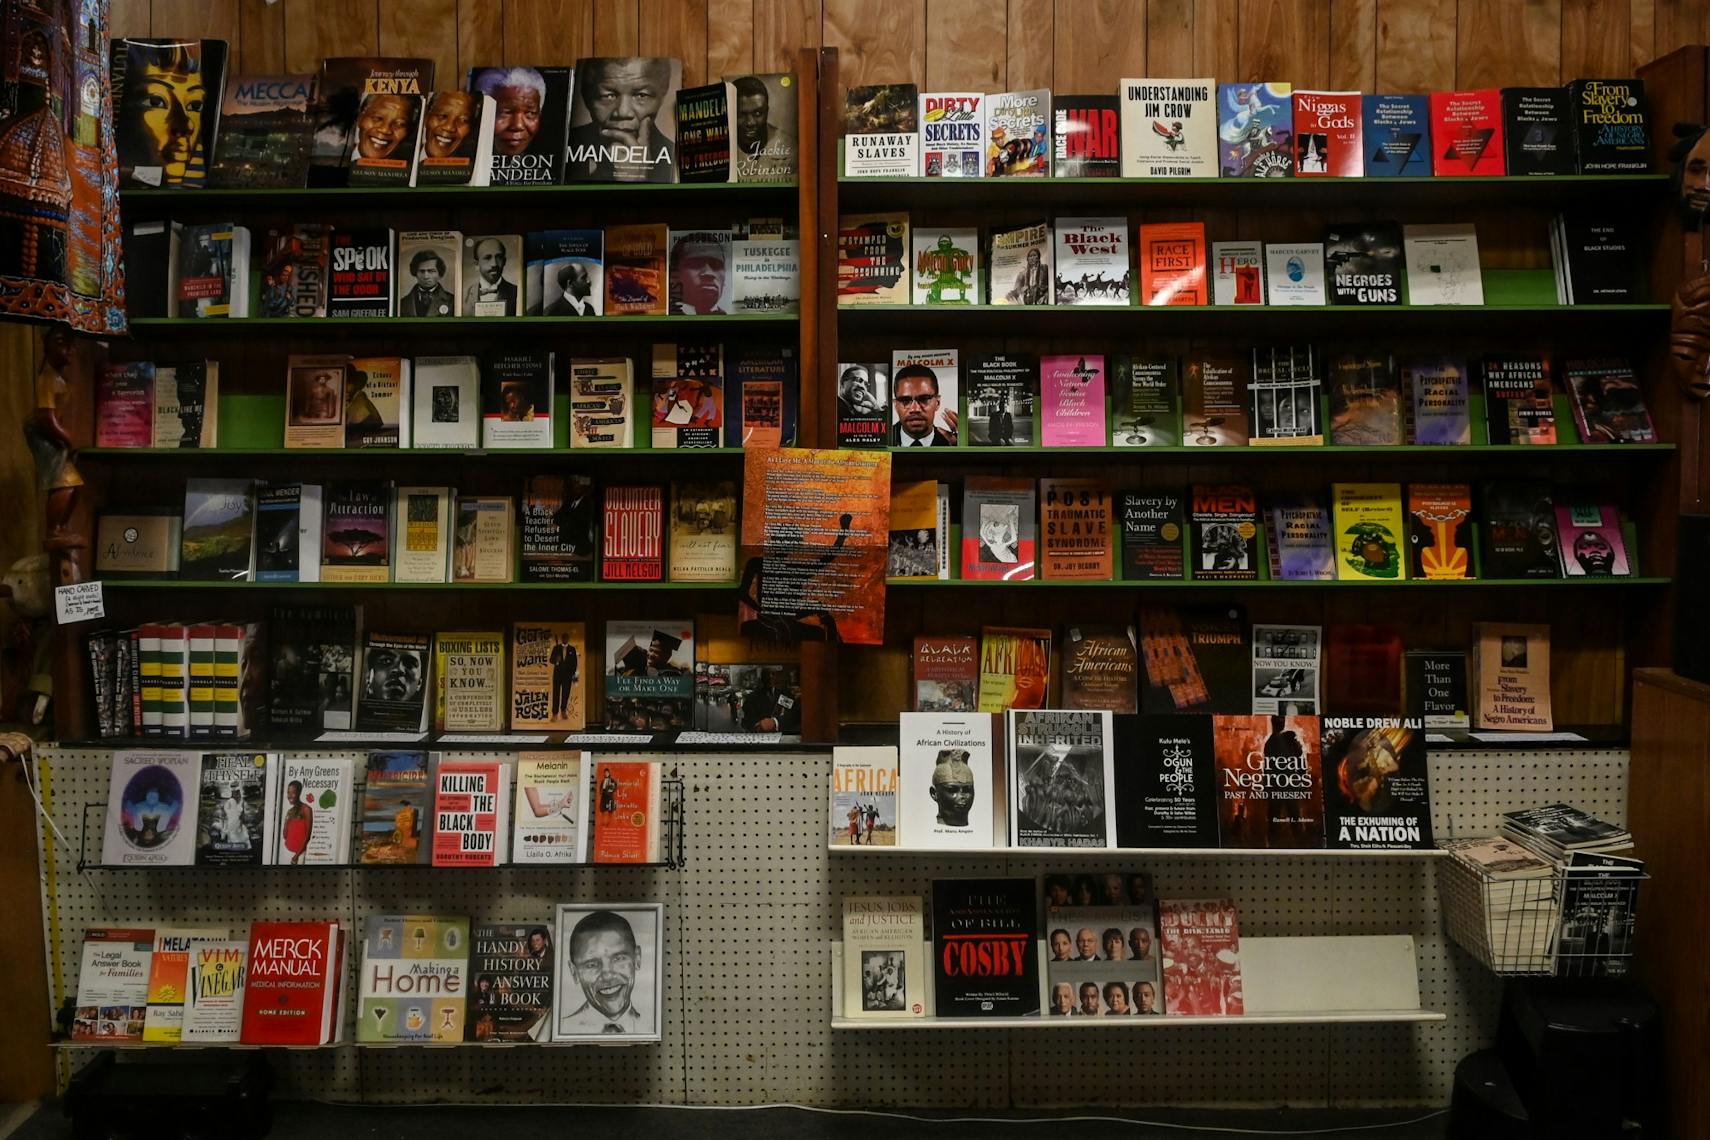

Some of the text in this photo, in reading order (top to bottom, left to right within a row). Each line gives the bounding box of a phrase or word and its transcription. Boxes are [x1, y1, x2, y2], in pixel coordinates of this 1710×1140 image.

[235, 81, 309, 100] MECCA
[365, 79, 420, 94] KENYA
[1586, 82, 1630, 96] From
[1128, 86, 1208, 101] UNDERSTANDING
[925, 98, 980, 112] DIRTY
[1001, 95, 1037, 108] More
[1298, 99, 1346, 116] Niggas
[679, 99, 728, 122] MANDELA
[1145, 104, 1192, 118] JIM CROW
[989, 115, 1044, 129] Secrets
[1583, 111, 1643, 124] Freedom
[925, 123, 980, 142] SECRETS
[852, 136, 912, 147] RUNAWAY
[565, 145, 671, 165] MANDELA
[858, 148, 905, 158] SLAVES
[1151, 167, 1191, 175] DAVID PILGRIM
[848, 235, 886, 245] STAMPED
[1064, 233, 1122, 244] Black
[743, 248, 790, 256] TUSKEGEE
[1072, 245, 1119, 255] West
[1157, 245, 1189, 255] RACE
[736, 264, 797, 272] PHILADELPHIA
[1156, 257, 1192, 267] FIRST
[854, 267, 900, 276] BEGINNING
[1336, 274, 1392, 286] NEGROES
[1337, 287, 1397, 302] WITH GUNS
[897, 359, 944, 367] MALCOLM
[1503, 362, 1541, 370] REASONS
[1488, 372, 1506, 380] WHY
[1489, 381, 1534, 389] AMERICANS
[1424, 388, 1459, 396] RACIAL
[1419, 399, 1465, 407] PERSONALITY
[840, 422, 886, 434] MALCOLM X
[606, 487, 660, 510] VOLUNTEER
[1047, 491, 1105, 507] POST
[1125, 496, 1178, 509] Slavery by
[1193, 497, 1255, 512] MEN
[329, 503, 384, 515] Attraction
[1048, 509, 1105, 519] TRAUMATIC
[1125, 509, 1168, 520] Another
[1048, 522, 1105, 535] SLAVE
[1125, 522, 1156, 532] Name
[605, 512, 660, 557] SLAVERY
[1282, 531, 1327, 539] PERSONALITY
[561, 544, 576, 553] City
[1048, 538, 1105, 548] SYNDROME
[605, 563, 659, 577] JILL NELSON
[77, 584, 98, 592] CARVED
[1192, 632, 1241, 644] TRIUMPH
[439, 641, 500, 653] BOXING LISTS
[920, 643, 971, 654] BLACK
[1077, 639, 1128, 657] African
[1067, 657, 1134, 674] Americans
[1425, 661, 1450, 670] More
[1425, 674, 1451, 684] Than
[1428, 688, 1449, 697] One
[1501, 684, 1527, 694] Slavery
[515, 691, 548, 705] JALEN
[516, 703, 548, 720] ROSE
[1425, 701, 1455, 712] Flavor
[1493, 705, 1498, 713] A
[1500, 705, 1526, 715] History
[1023, 713, 1094, 723] AFRIKAN
[1324, 718, 1422, 729] NOBLE DREW ALI
[1484, 714, 1547, 725] Negro Americans
[943, 729, 962, 737] History
[1017, 724, 1102, 735] STRUGGLE
[916, 738, 986, 747] African Civilizations
[1017, 735, 1102, 746] INHERITED
[216, 756, 249, 768] HEAL
[536, 761, 568, 771] Melanin
[1163, 758, 1193, 769] OGUN
[1246, 752, 1308, 770] Great
[288, 767, 339, 776] By Any Greens
[302, 779, 339, 790] Necessary
[441, 775, 484, 793] KILLING
[834, 767, 896, 792] AFRICA
[1159, 774, 1193, 784] PEOPLE
[1223, 768, 1312, 792] Negroes
[1224, 791, 1312, 800] PAST AND PRESENT
[473, 795, 494, 812] THE
[439, 814, 473, 831] BLACK
[1339, 817, 1418, 827] THE EXHUMING OF
[1338, 827, 1420, 842] A NATION
[463, 832, 492, 850] BODY
[849, 915, 915, 925] and JUSTICE
[254, 939, 322, 959] MERCK
[477, 941, 527, 953] HANDY
[202, 949, 239, 963] VIM
[943, 941, 1029, 977] COSBY
[91, 960, 120, 968] Answer
[252, 960, 321, 976] MANUAL
[483, 958, 543, 972] HISTORY
[372, 965, 460, 993] Home
[492, 975, 549, 989] ANSWER
[500, 993, 542, 1005] BOOK
